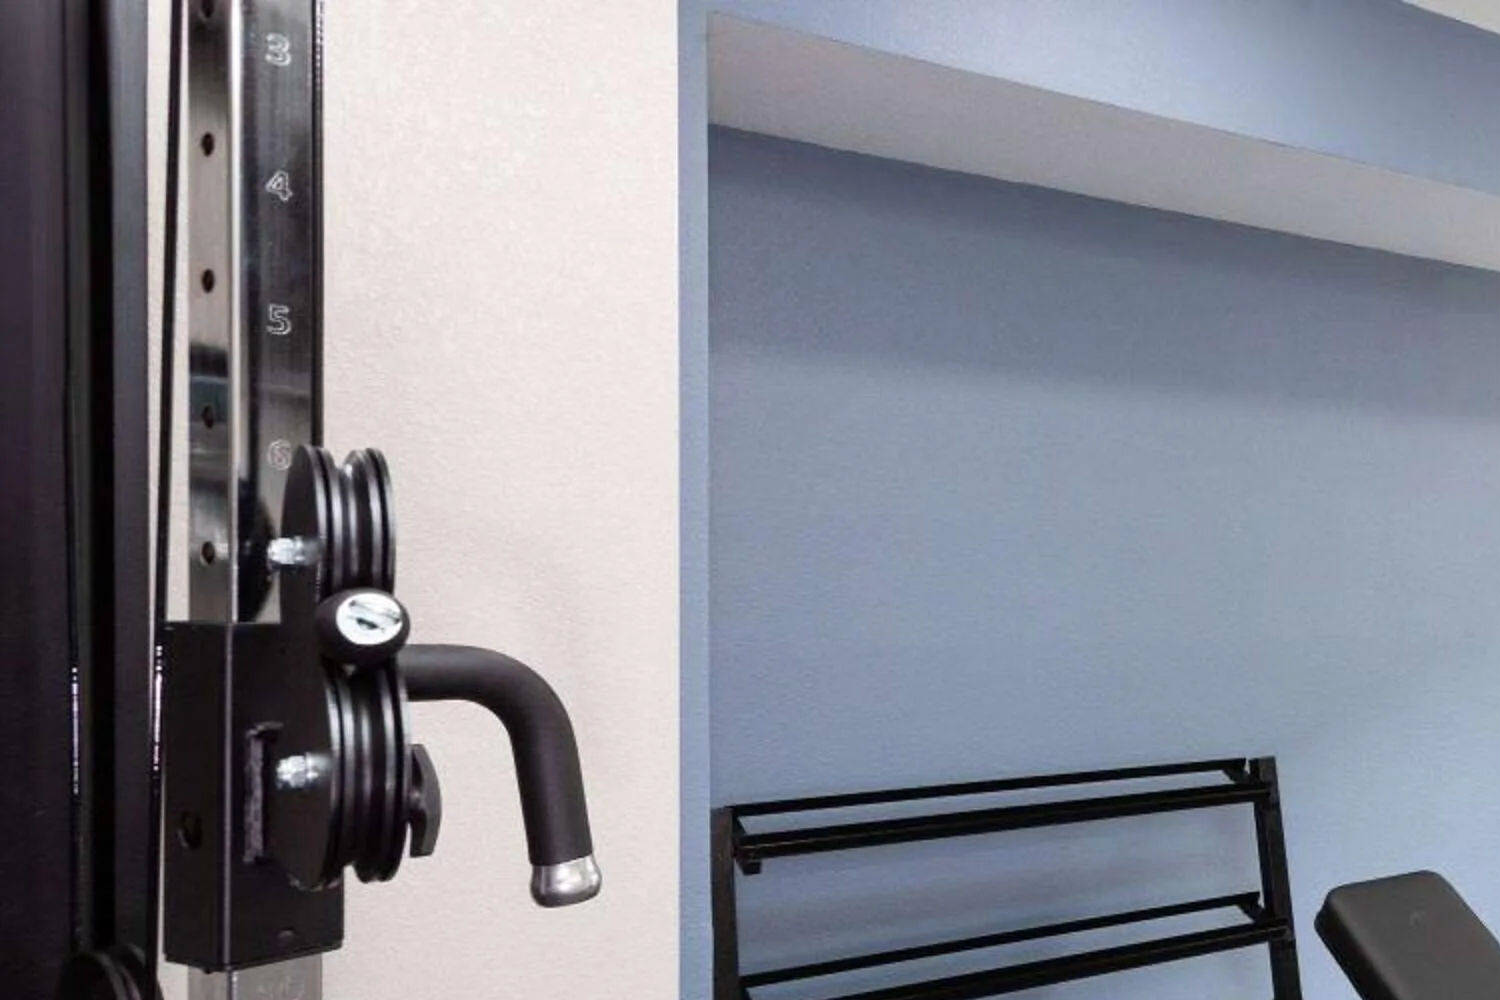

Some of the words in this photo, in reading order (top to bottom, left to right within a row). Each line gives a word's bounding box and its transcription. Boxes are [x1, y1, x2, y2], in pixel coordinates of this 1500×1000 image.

[264, 32, 292, 66] 3
[265, 170, 292, 201] 4
[267, 304, 292, 335] 5
[267, 439, 292, 470] 6
